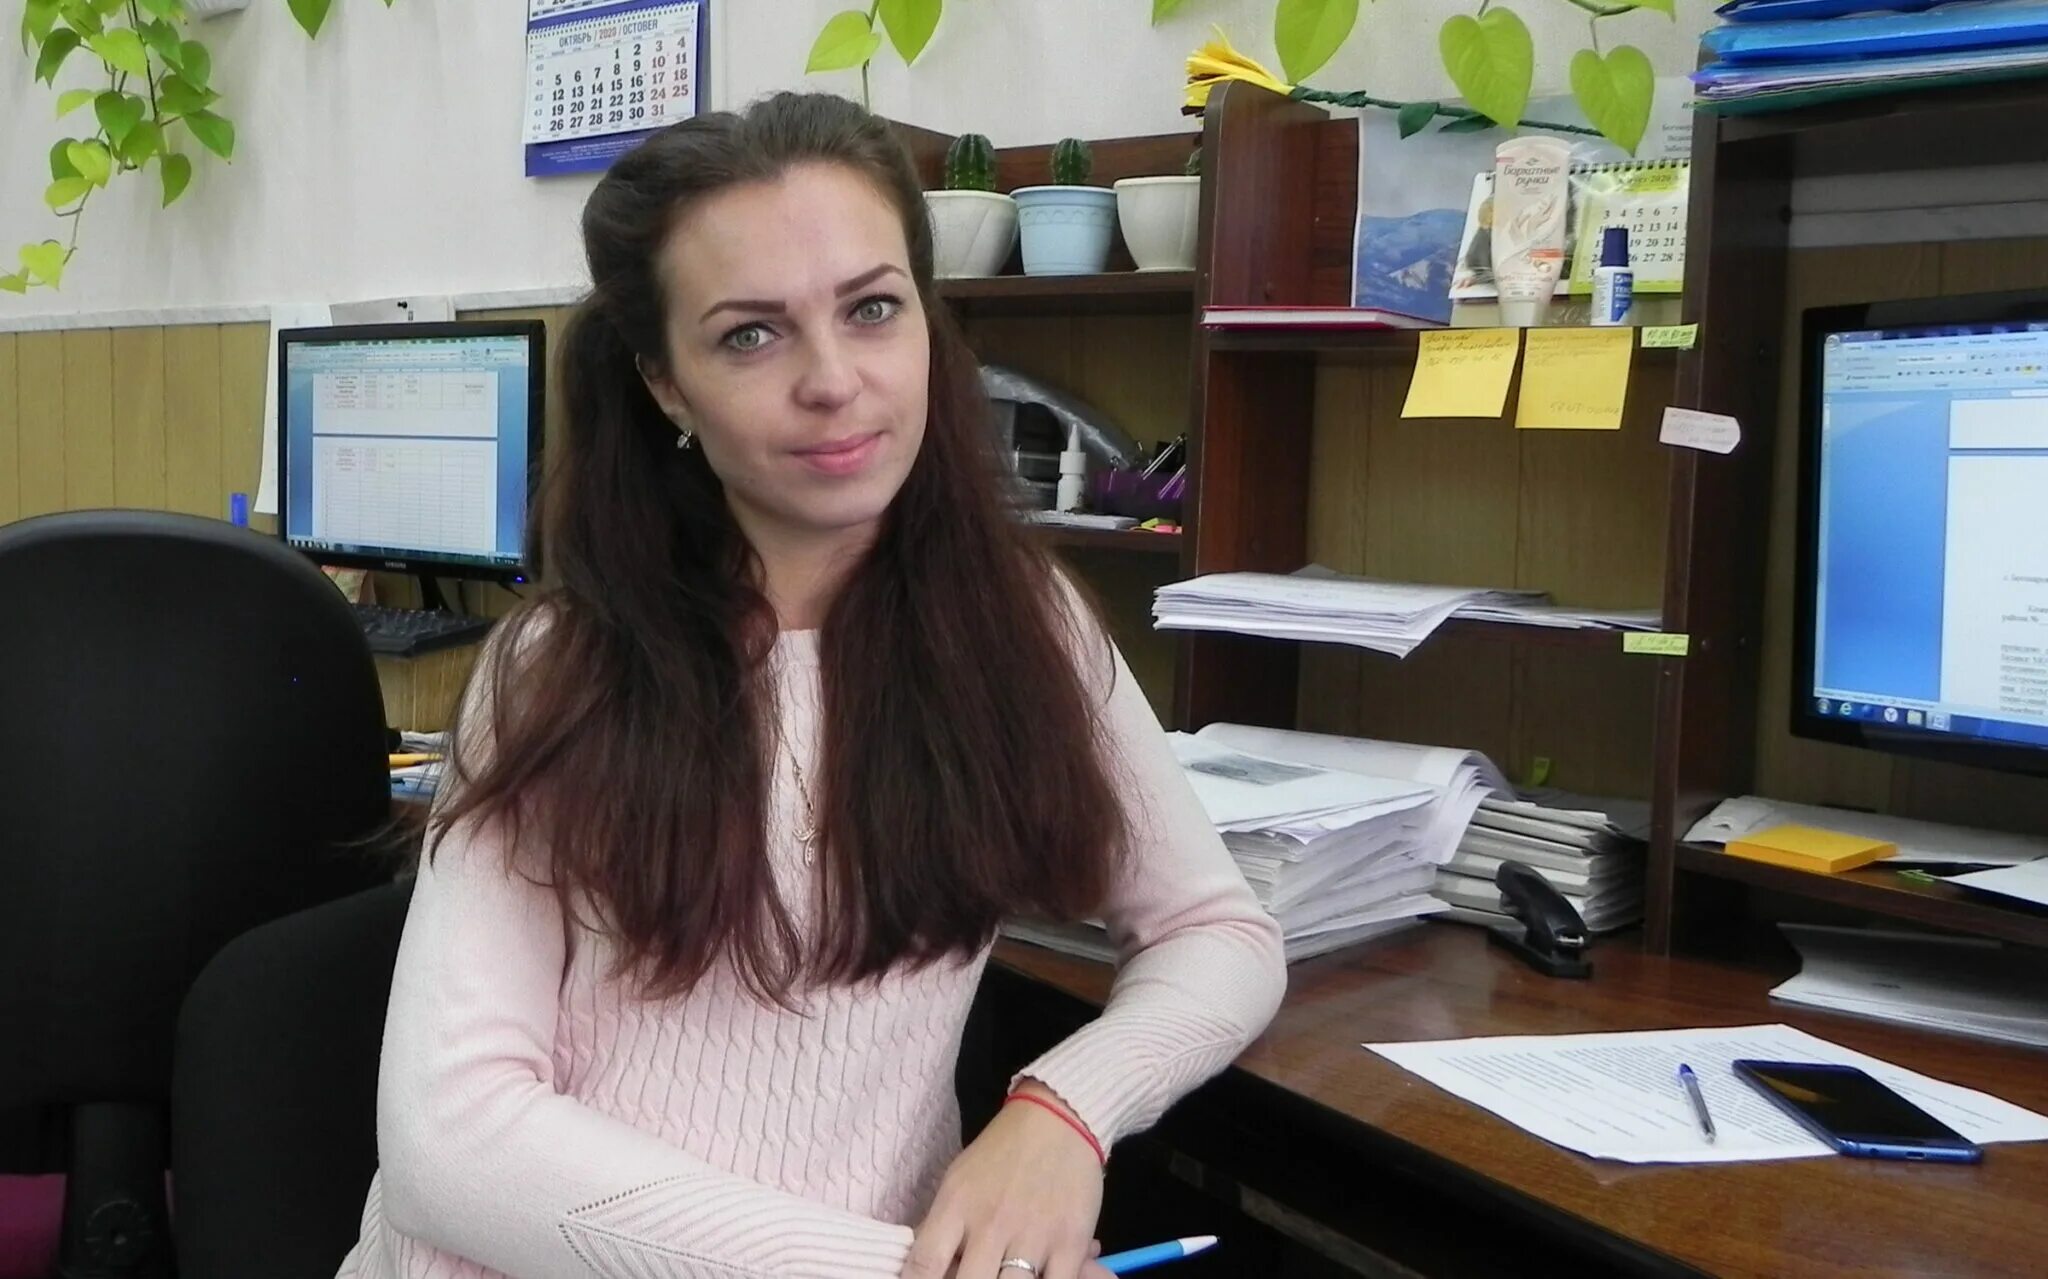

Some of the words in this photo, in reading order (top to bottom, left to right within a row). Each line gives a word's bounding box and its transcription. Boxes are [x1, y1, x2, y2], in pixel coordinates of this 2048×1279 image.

[559, 33, 592, 48] ОКТЯБРЬ
[623, 19, 659, 36] OCTOBER
[615, 48, 620, 59] 1
[633, 43, 641, 56] 2
[656, 40, 663, 52] 3
[677, 36, 686, 48] 4
[555, 74, 562, 86] 5
[574, 70, 582, 82] 6
[594, 67, 601, 79] 7
[613, 63, 620, 75] 8
[633, 59, 641, 71] 9
[652, 56, 665, 68] 10
[675, 52, 687, 65] 11
[552, 89, 564, 101] 12
[572, 85, 584, 98] 13
[592, 82, 603, 95] 14
[611, 79, 623, 91] 15
[631, 75, 643, 88] 16
[652, 72, 665, 84] 17
[674, 68, 687, 81] 18
[552, 104, 564, 116] 19
[570, 101, 584, 113] 20
[591, 98, 602, 110] 21
[609, 94, 623, 107] 22
[629, 91, 644, 104] 23
[650, 88, 666, 101] 24
[672, 84, 689, 97] 25
[550, 119, 564, 131] 26
[570, 116, 583, 128] 27
[589, 112, 603, 126] 28
[609, 110, 623, 123] 29
[629, 106, 644, 119] 30
[651, 104, 664, 116] 31
[1515, 176, 1550, 187] ручки
[1604, 210, 1610, 219] 3
[1620, 209, 1626, 217] 4
[1637, 208, 1643, 217] 5
[1653, 208, 1660, 216] 6
[1672, 206, 1678, 215] 7
[1632, 224, 1643, 233] 12
[1649, 222, 1661, 232] 13
[1666, 222, 1678, 231] 14
[1630, 239, 1641, 248] 19
[1646, 238, 1658, 248] 20
[1663, 238, 1674, 247] 21
[1642, 253, 1655, 262] 27
[1660, 253, 1673, 262] 28
